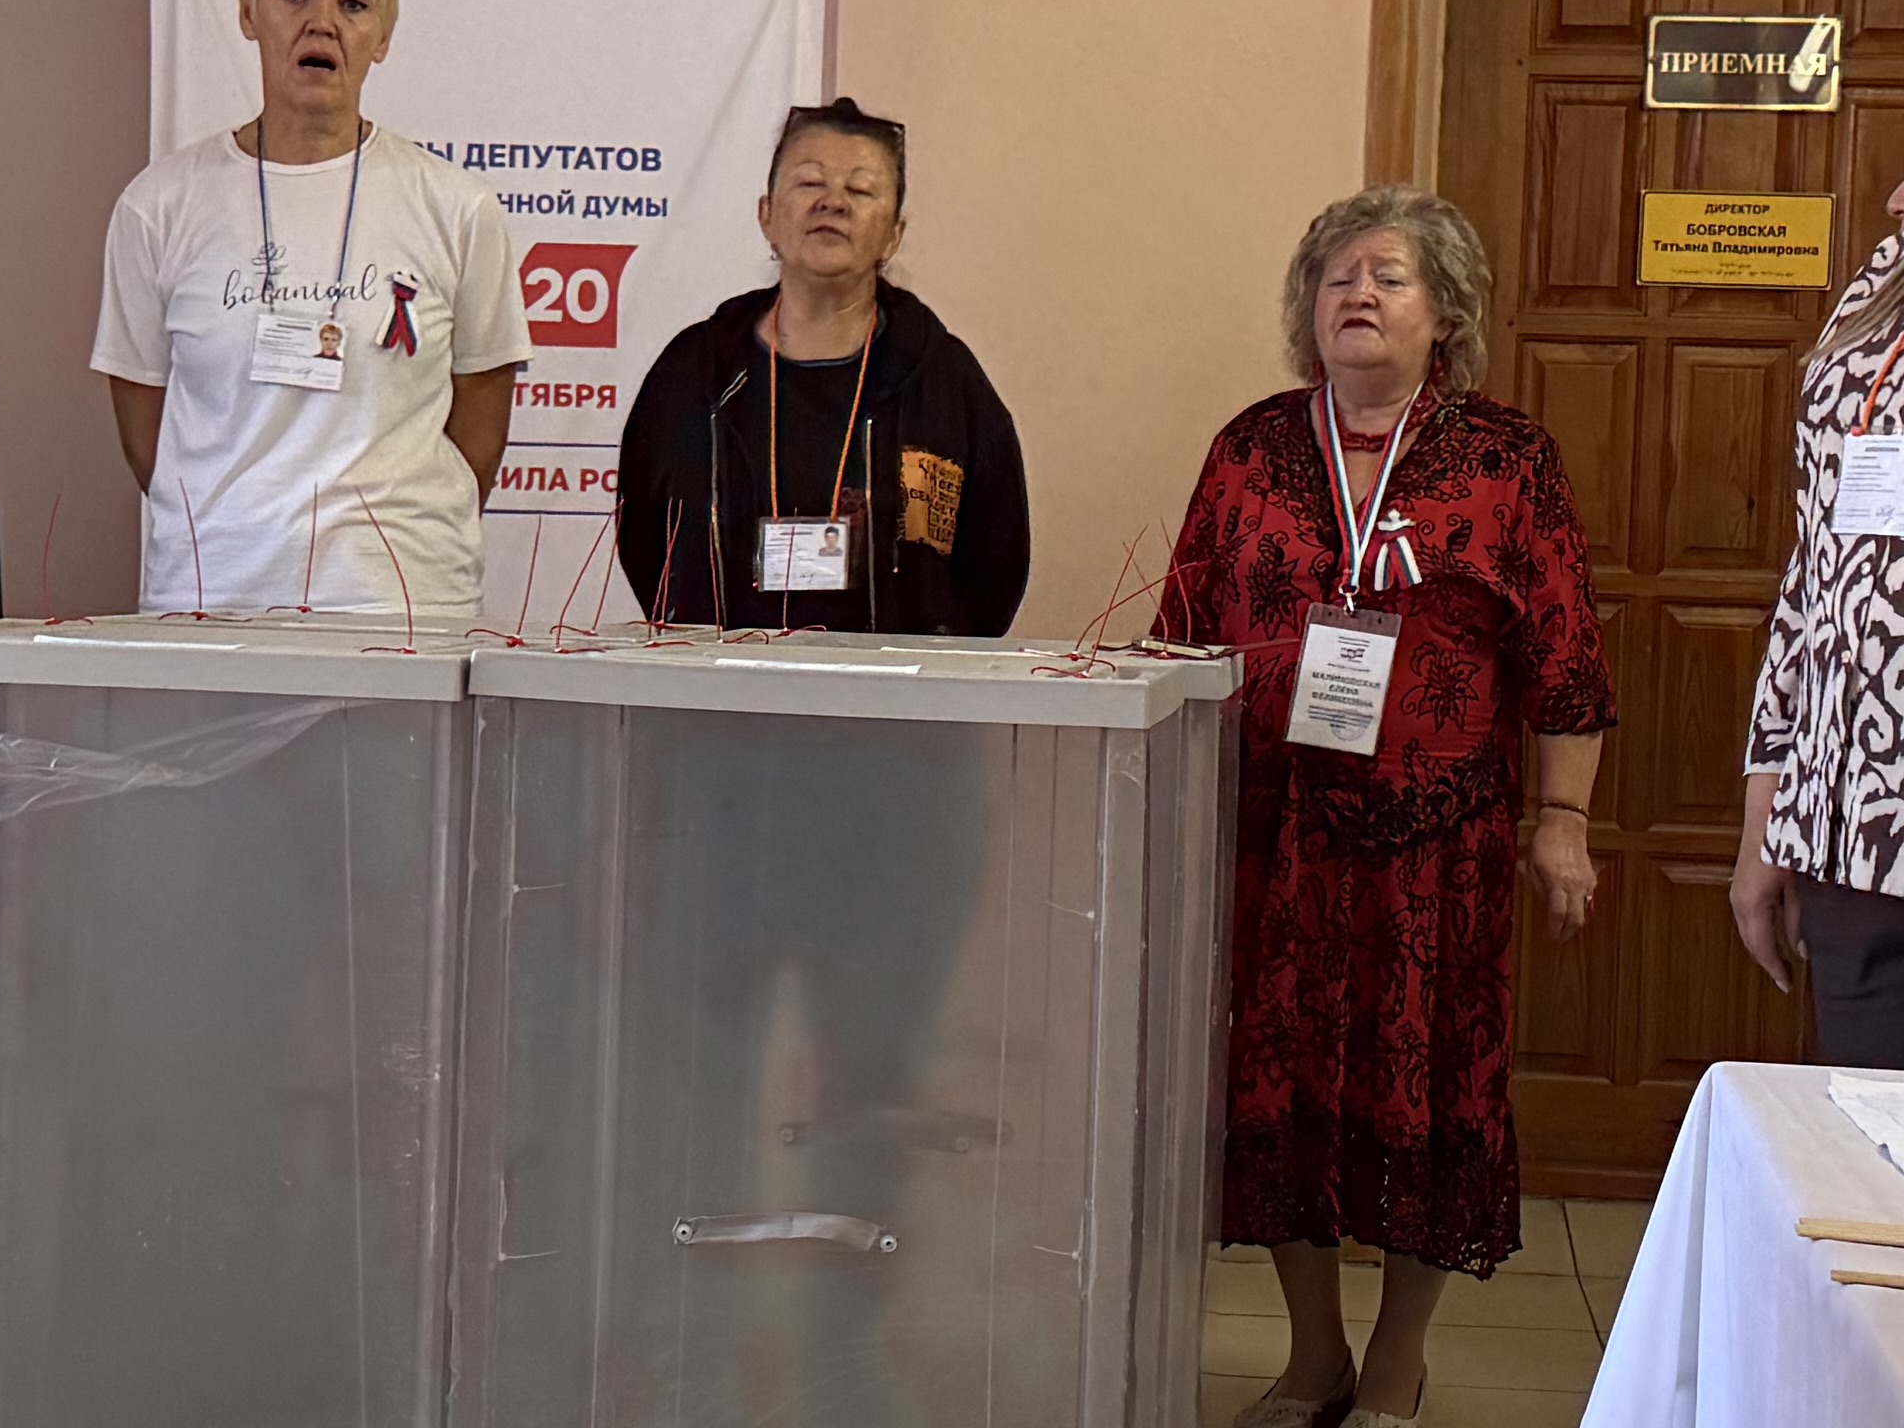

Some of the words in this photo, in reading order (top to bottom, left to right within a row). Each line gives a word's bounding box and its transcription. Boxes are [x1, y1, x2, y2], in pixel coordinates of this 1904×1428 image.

[1661, 52, 1827, 75] ПРИЕМНАЯ
[463, 143, 662, 172] ДЕПУТАТОВ
[583, 195, 668, 219] ДУМЫ
[1705, 203, 1770, 215] ДИРЕКТОР
[1686, 223, 1786, 238] БОБРОВСКАЯ
[524, 267, 610, 324] 20
